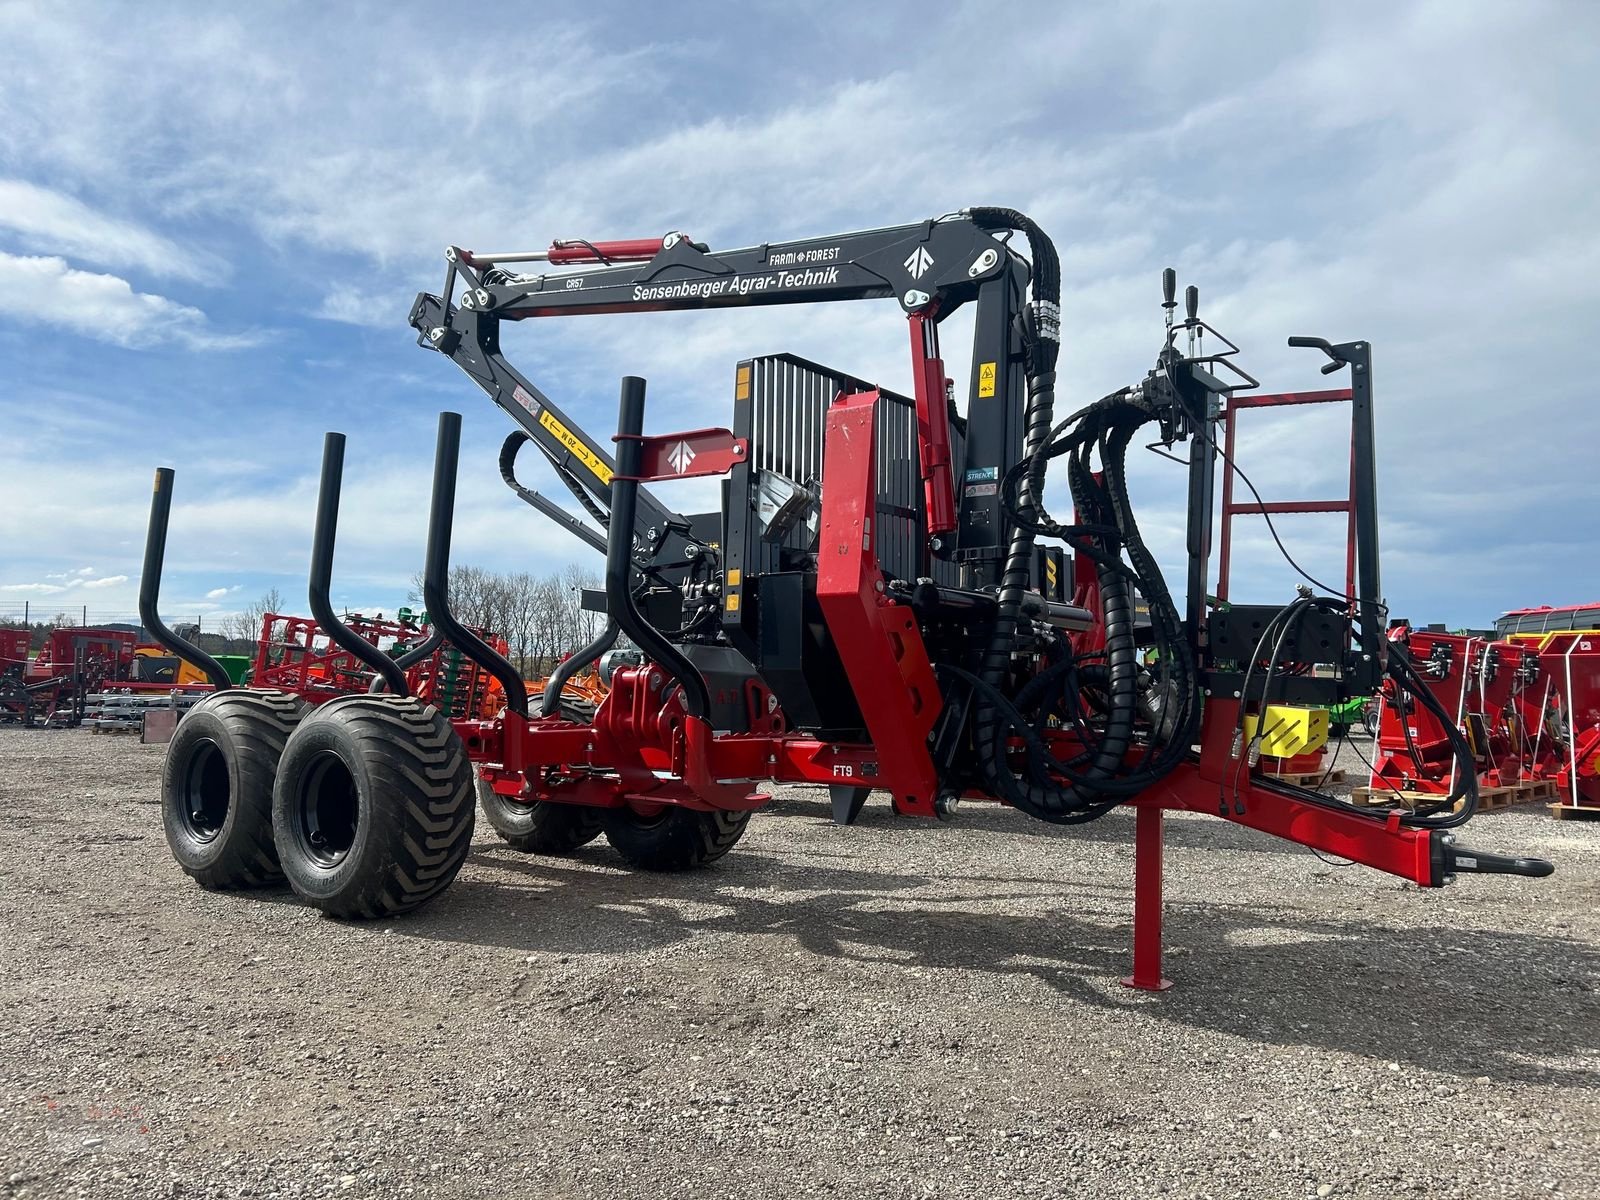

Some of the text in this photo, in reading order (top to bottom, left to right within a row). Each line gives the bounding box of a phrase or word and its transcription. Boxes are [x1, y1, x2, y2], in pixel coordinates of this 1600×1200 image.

[769, 248, 840, 266] FARMI FOREST
[566, 278, 584, 289] CR57
[632, 266, 840, 301] Sensenberger Agrar-Technik
[567, 437, 577, 449] 20
[833, 765, 853, 777] FT9
